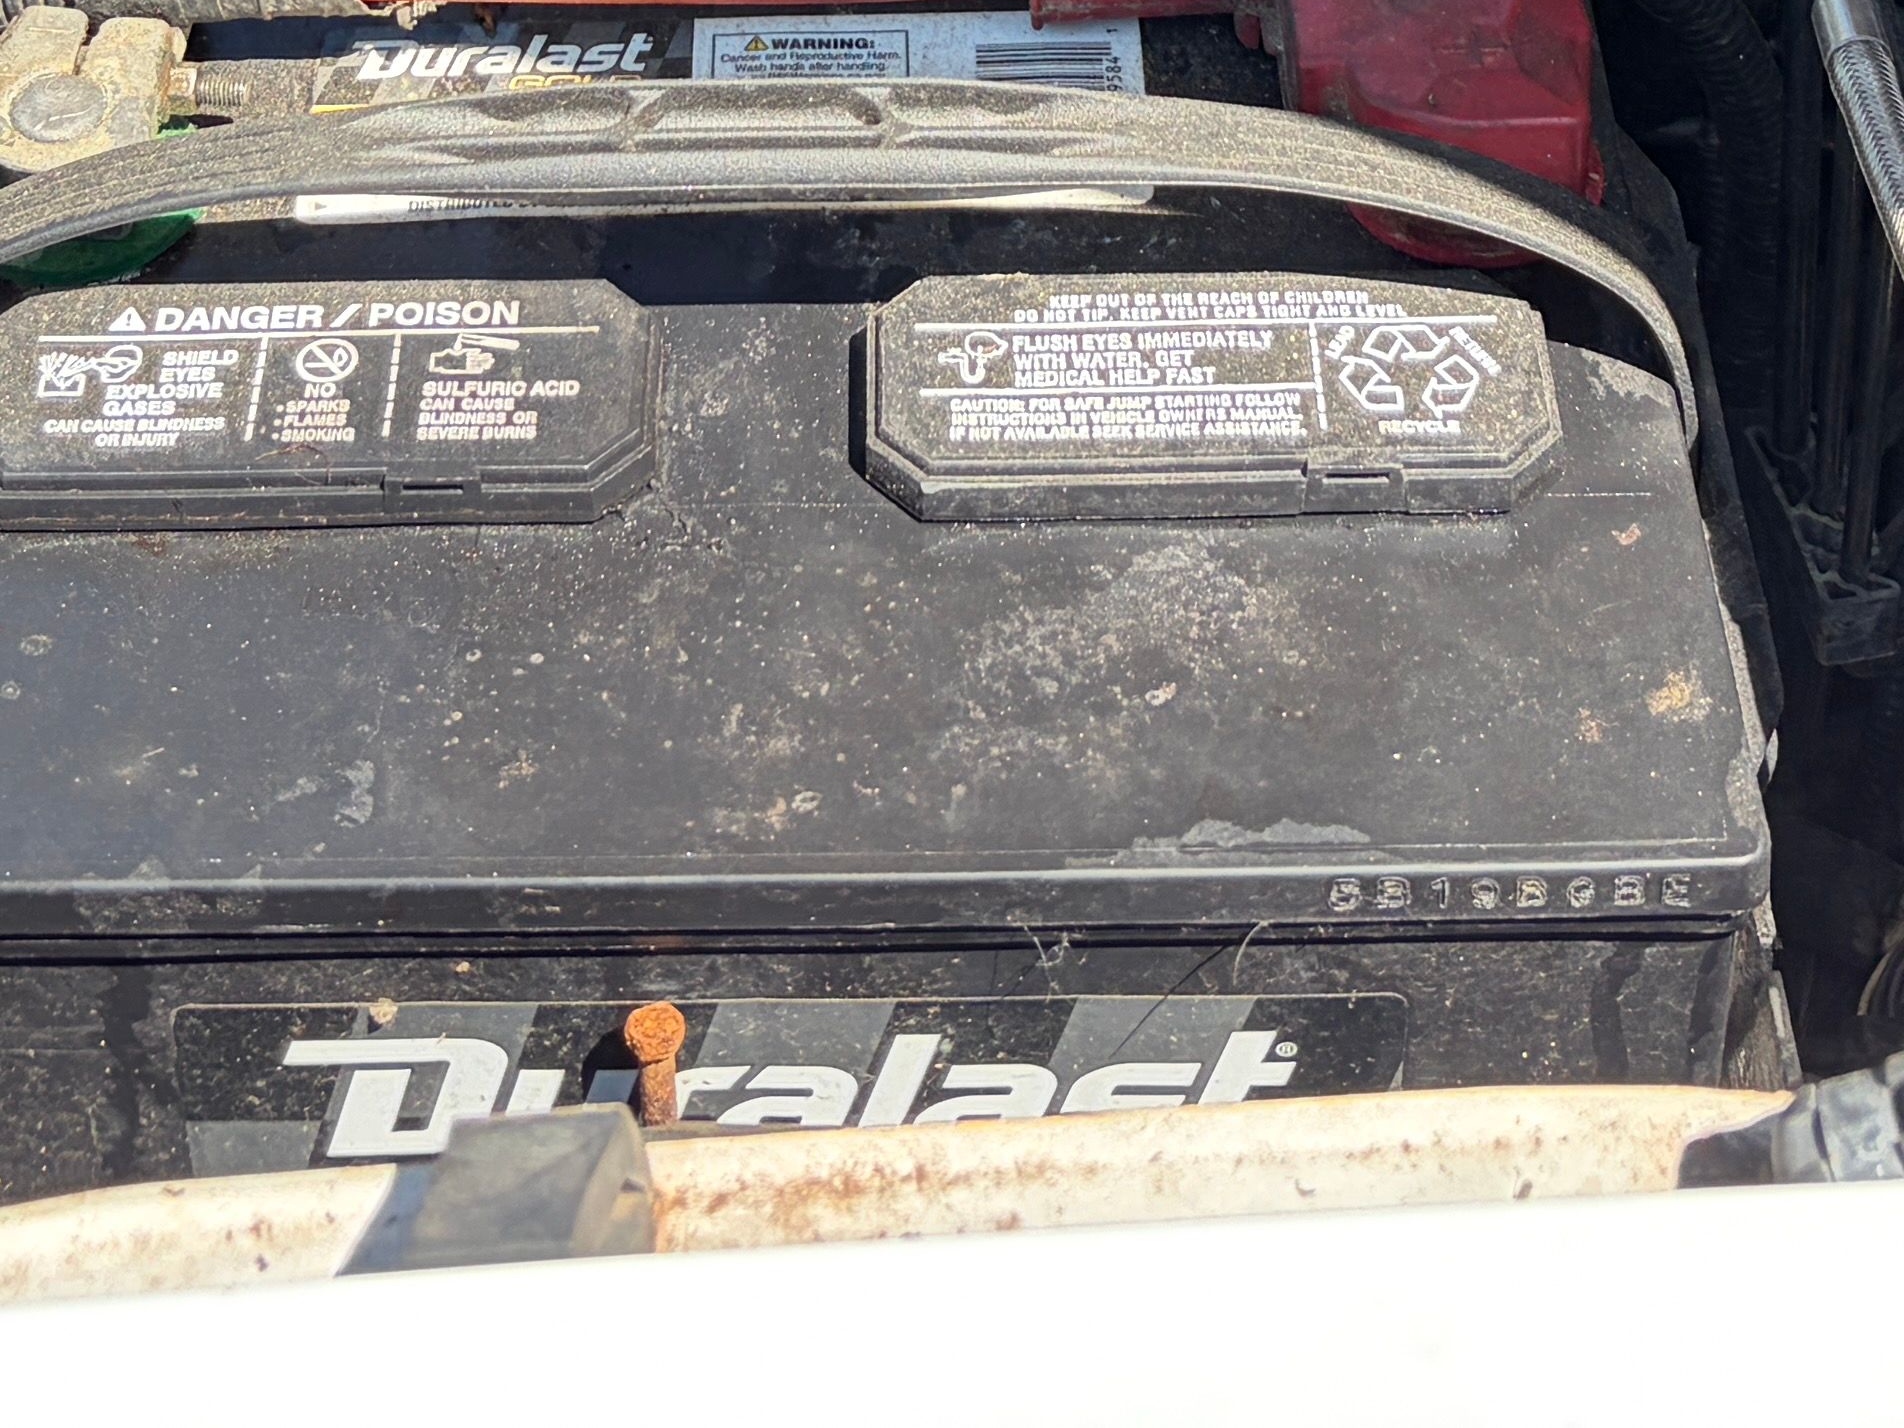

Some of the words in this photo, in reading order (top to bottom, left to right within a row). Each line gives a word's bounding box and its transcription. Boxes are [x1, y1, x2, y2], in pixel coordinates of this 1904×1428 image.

[772, 37, 875, 50] WARNING:
[353, 33, 653, 80] Duralast
[1050, 295, 1089, 309] KEEP
[1096, 295, 1130, 307] OUT
[1134, 294, 1157, 306] OF
[1161, 293, 1193, 305] THE
[1198, 292, 1253, 305] REACH
[1258, 291, 1279, 304] OF
[1284, 291, 1369, 304] CHILDREN
[155, 305, 322, 332] DANGER
[368, 301, 520, 327] POISON
[1014, 310, 1039, 322] DO
[1044, 309, 1078, 321] NOT
[1120, 308, 1161, 320] KEEP
[1166, 307, 1210, 319] VENT
[1215, 306, 1257, 318] CAPS
[1263, 305, 1312, 318] TIGHT
[1317, 305, 1351, 317] AND
[1012, 334, 1082, 353] FLUSH
[1085, 333, 1134, 351] EYES
[1138, 330, 1273, 350] IMMEDIATELY
[163, 350, 239, 366] SHIELD
[1014, 354, 1077, 370] WITH
[1156, 351, 1194, 367] GET
[159, 367, 215, 383] EYES
[1013, 370, 1105, 388] MEDICAL
[1109, 368, 1160, 385] HELP
[1165, 366, 1216, 384] FAST
[105, 382, 224, 399] EXPLOSIVE
[305, 383, 336, 398] NO
[423, 381, 527, 396] SULFURIC
[530, 380, 580, 395] ACID
[103, 401, 176, 416] GASES
[285, 399, 350, 413] SPARKS
[420, 398, 454, 410] CAN
[461, 398, 514, 410] CAUSE
[1028, 398, 1060, 411] FOR
[1064, 397, 1104, 410] SAFE
[1106, 397, 1151, 409] JUMP
[1155, 395, 1231, 408] STARTING
[1235, 393, 1301, 407] FOLLOW
[44, 419, 79, 433] CAN
[80, 418, 135, 432] CAUSE
[137, 417, 225, 431] BLINDNESS
[283, 414, 347, 426] FLAMES
[418, 412, 507, 425] BLINDNESS
[512, 411, 538, 424] OR
[951, 413, 1066, 426] INSTRUCTIONS
[1070, 412, 1087, 424] IN
[1090, 411, 1155, 424] VEHICLE
[280, 428, 355, 441] SMOKING
[417, 426, 479, 440] SEVERE
[482, 426, 537, 439] BURNS
[950, 427, 966, 440] IF
[969, 427, 1001, 440] NOT
[1092, 424, 1132, 438] SEEK
[1136, 423, 1200, 436] SERVICE
[1378, 420, 1461, 435] RECYCLE
[95, 434, 119, 447] OR
[120, 432, 179, 447] INJURY
